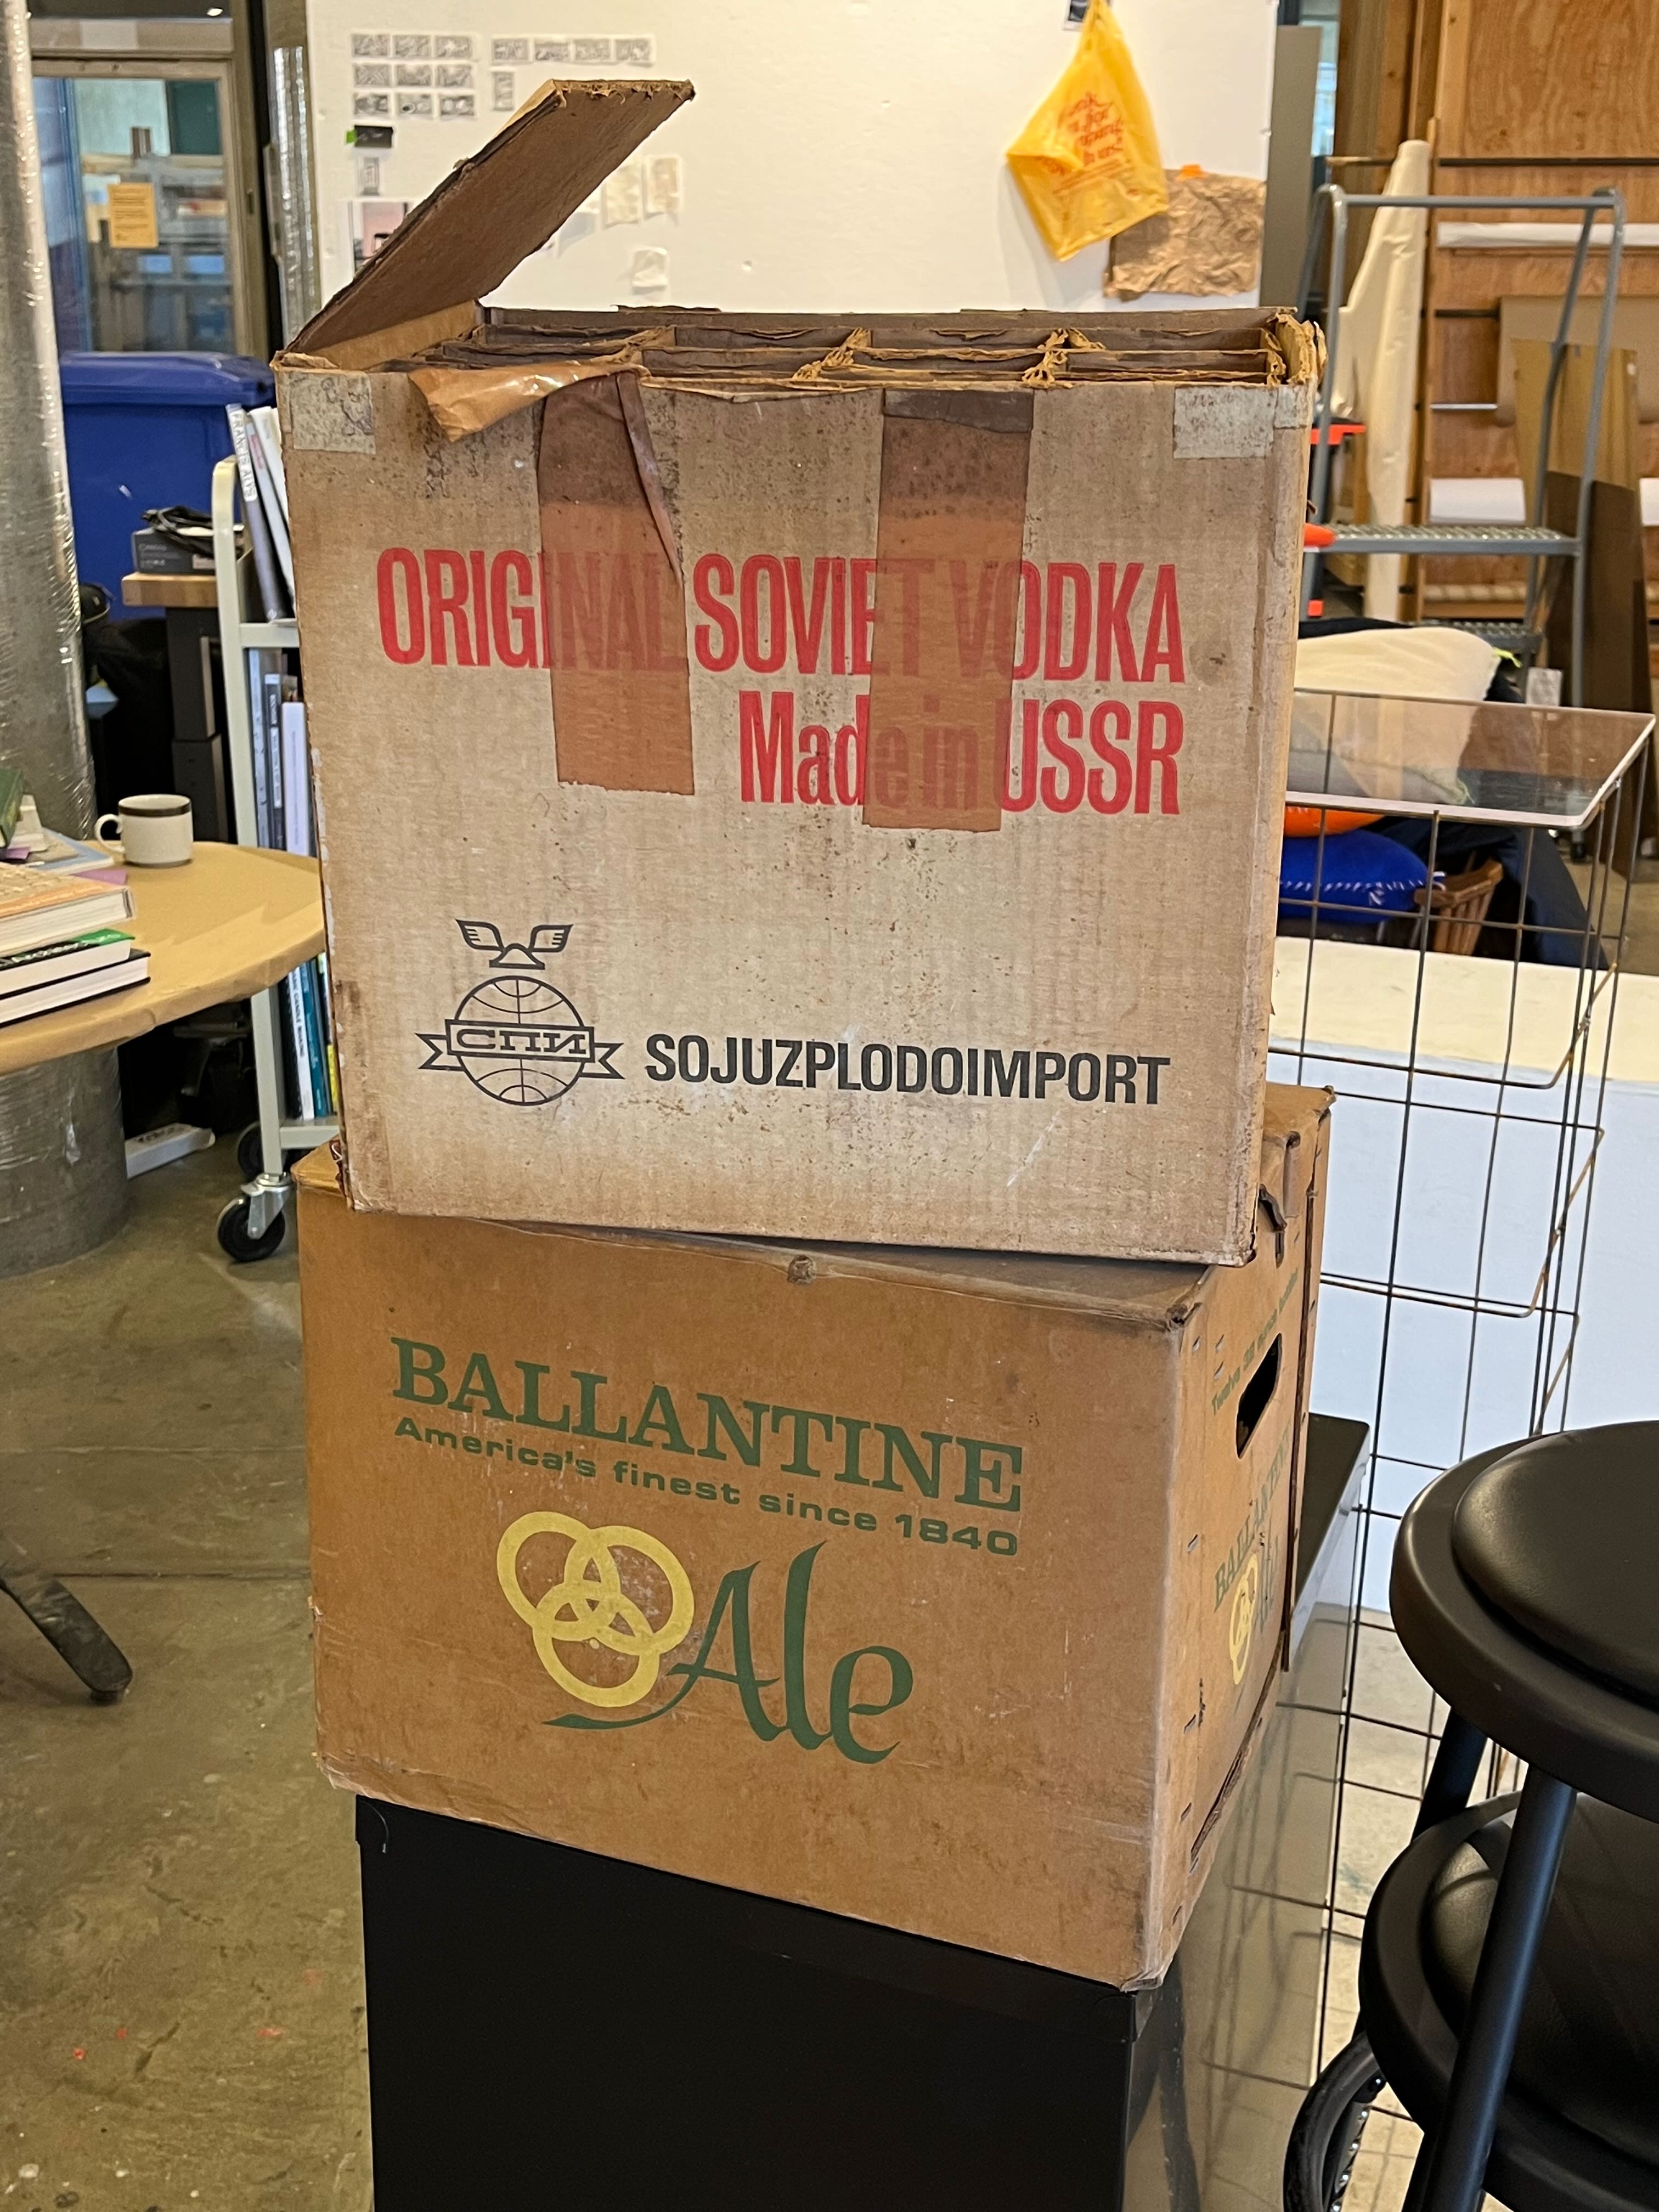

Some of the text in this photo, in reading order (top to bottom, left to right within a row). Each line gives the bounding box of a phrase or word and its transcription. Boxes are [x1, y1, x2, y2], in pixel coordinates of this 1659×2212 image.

[376, 548, 1186, 684] ORIGINAL SOVIET VODKA
[738, 690, 1184, 815] Made in USSR
[645, 1034, 1171, 1106] SOJUZPLODOIMPORT
[389, 1336, 1023, 1513] BALLANTINE
[394, 1417, 1018, 1556] America's finest since 1840
[541, 1540, 914, 1764] Ale
